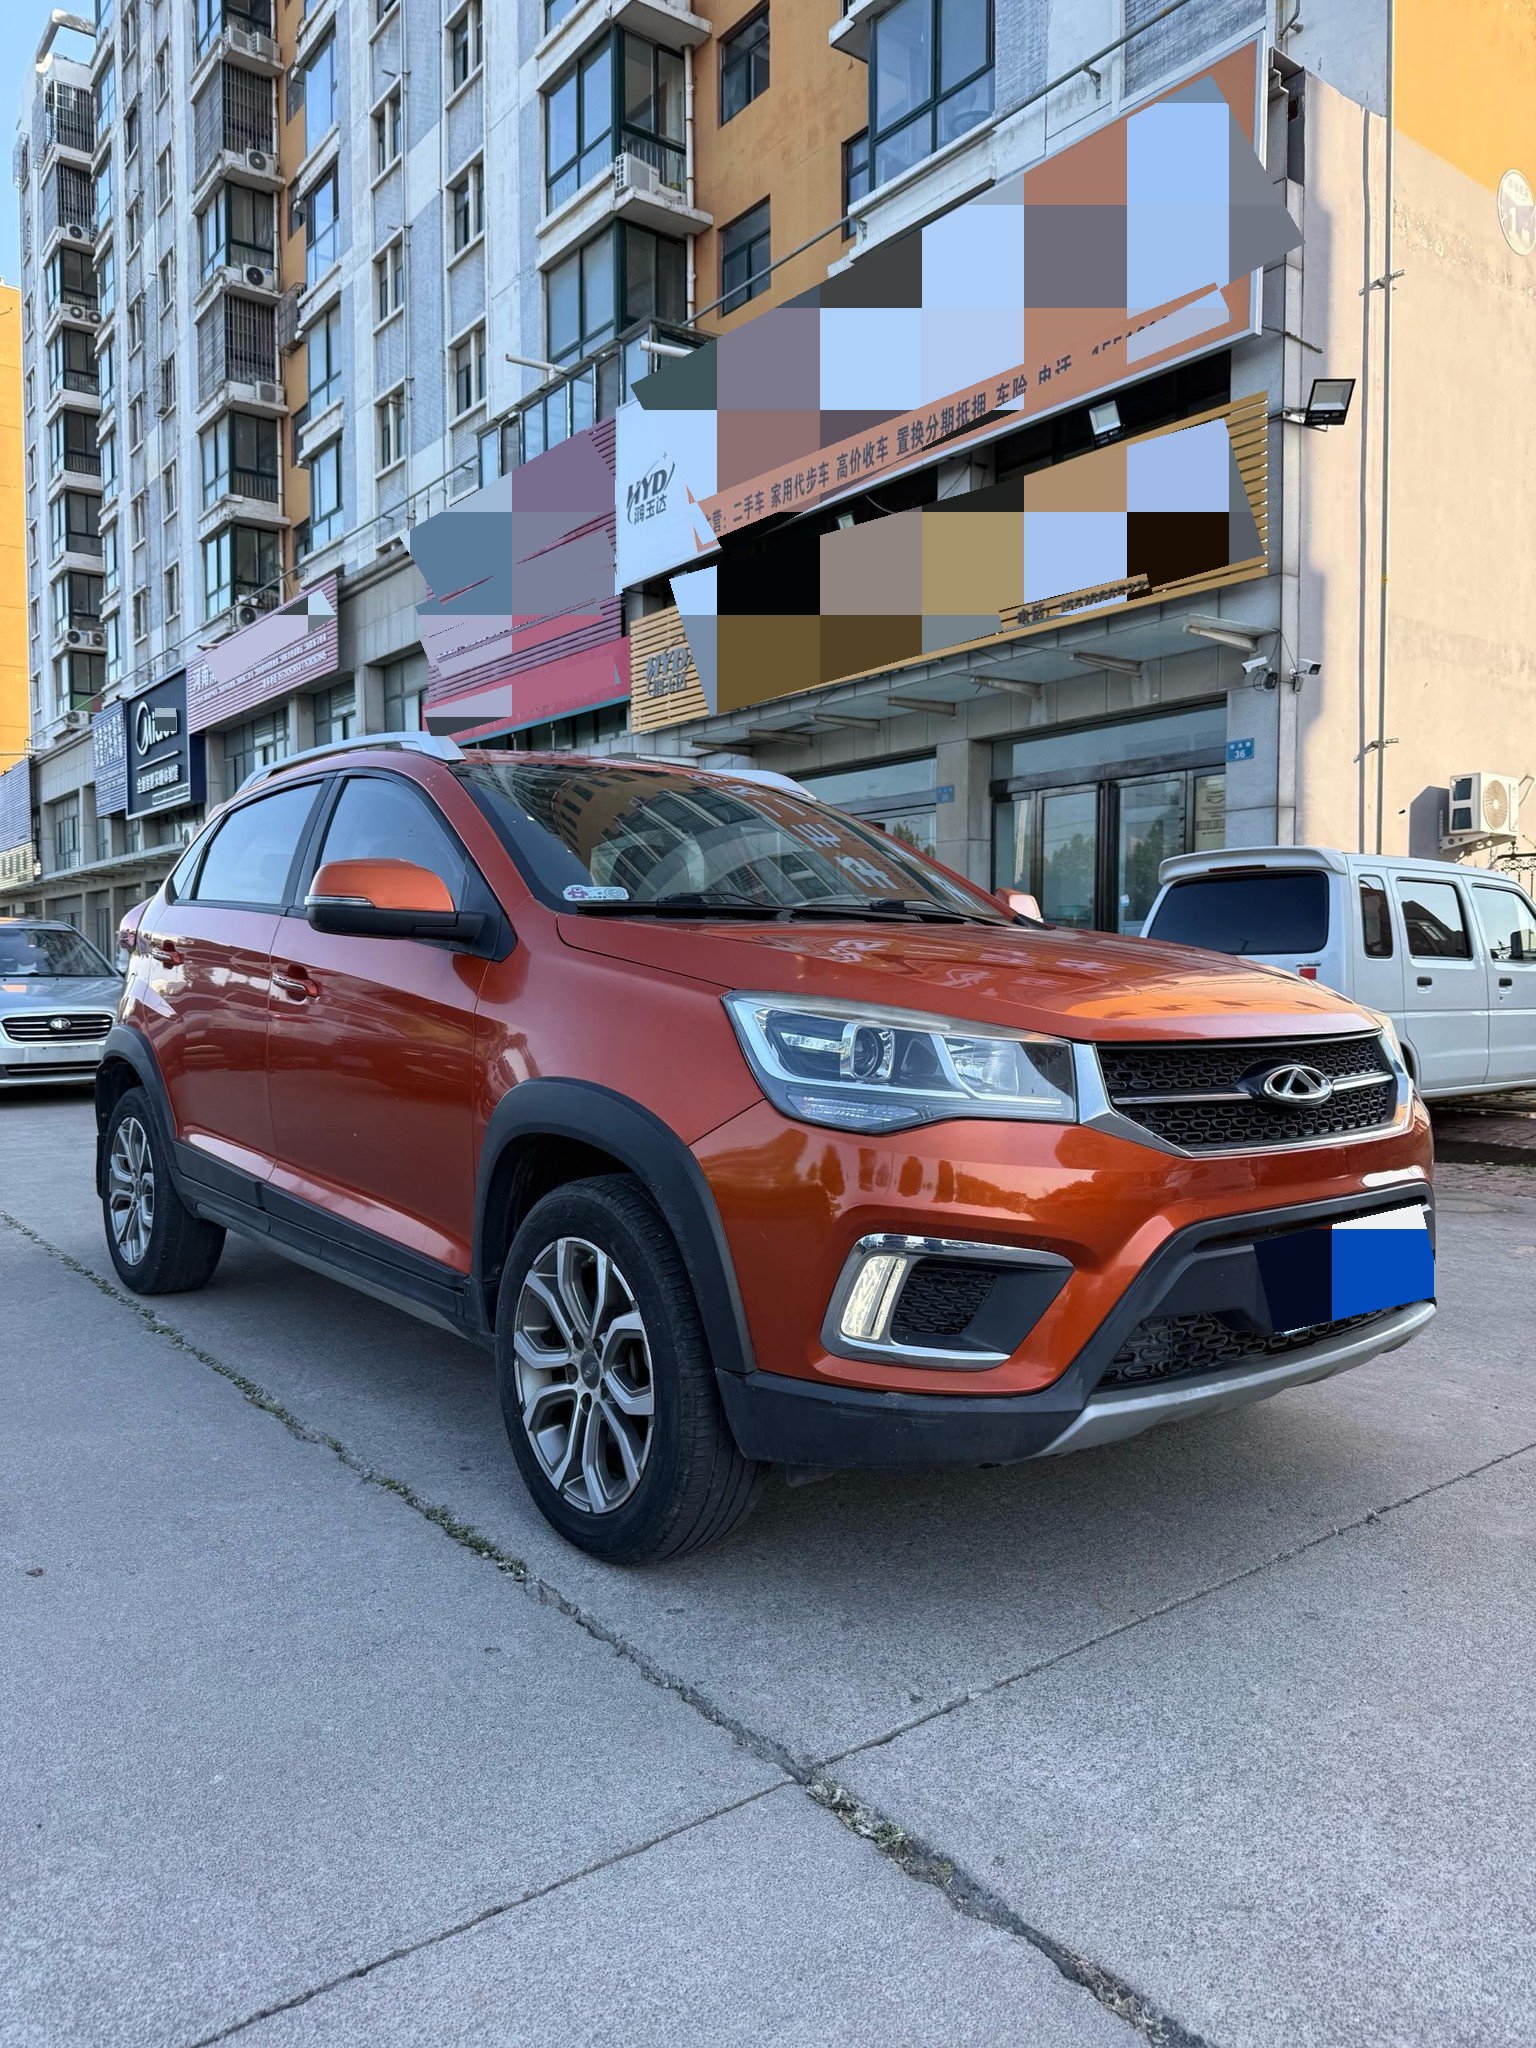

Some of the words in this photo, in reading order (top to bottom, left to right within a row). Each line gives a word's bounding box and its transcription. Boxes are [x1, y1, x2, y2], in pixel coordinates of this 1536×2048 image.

[732, 489, 765, 523] 二手车
[770, 461, 830, 509] 家用代步车
[836, 435, 889, 482] 高价收车
[896, 391, 987, 456] 置换分期抵押
[626, 469, 668, 509] HYD
[645, 646, 689, 679] HYD
[1234, 749, 1246, 759] 36
